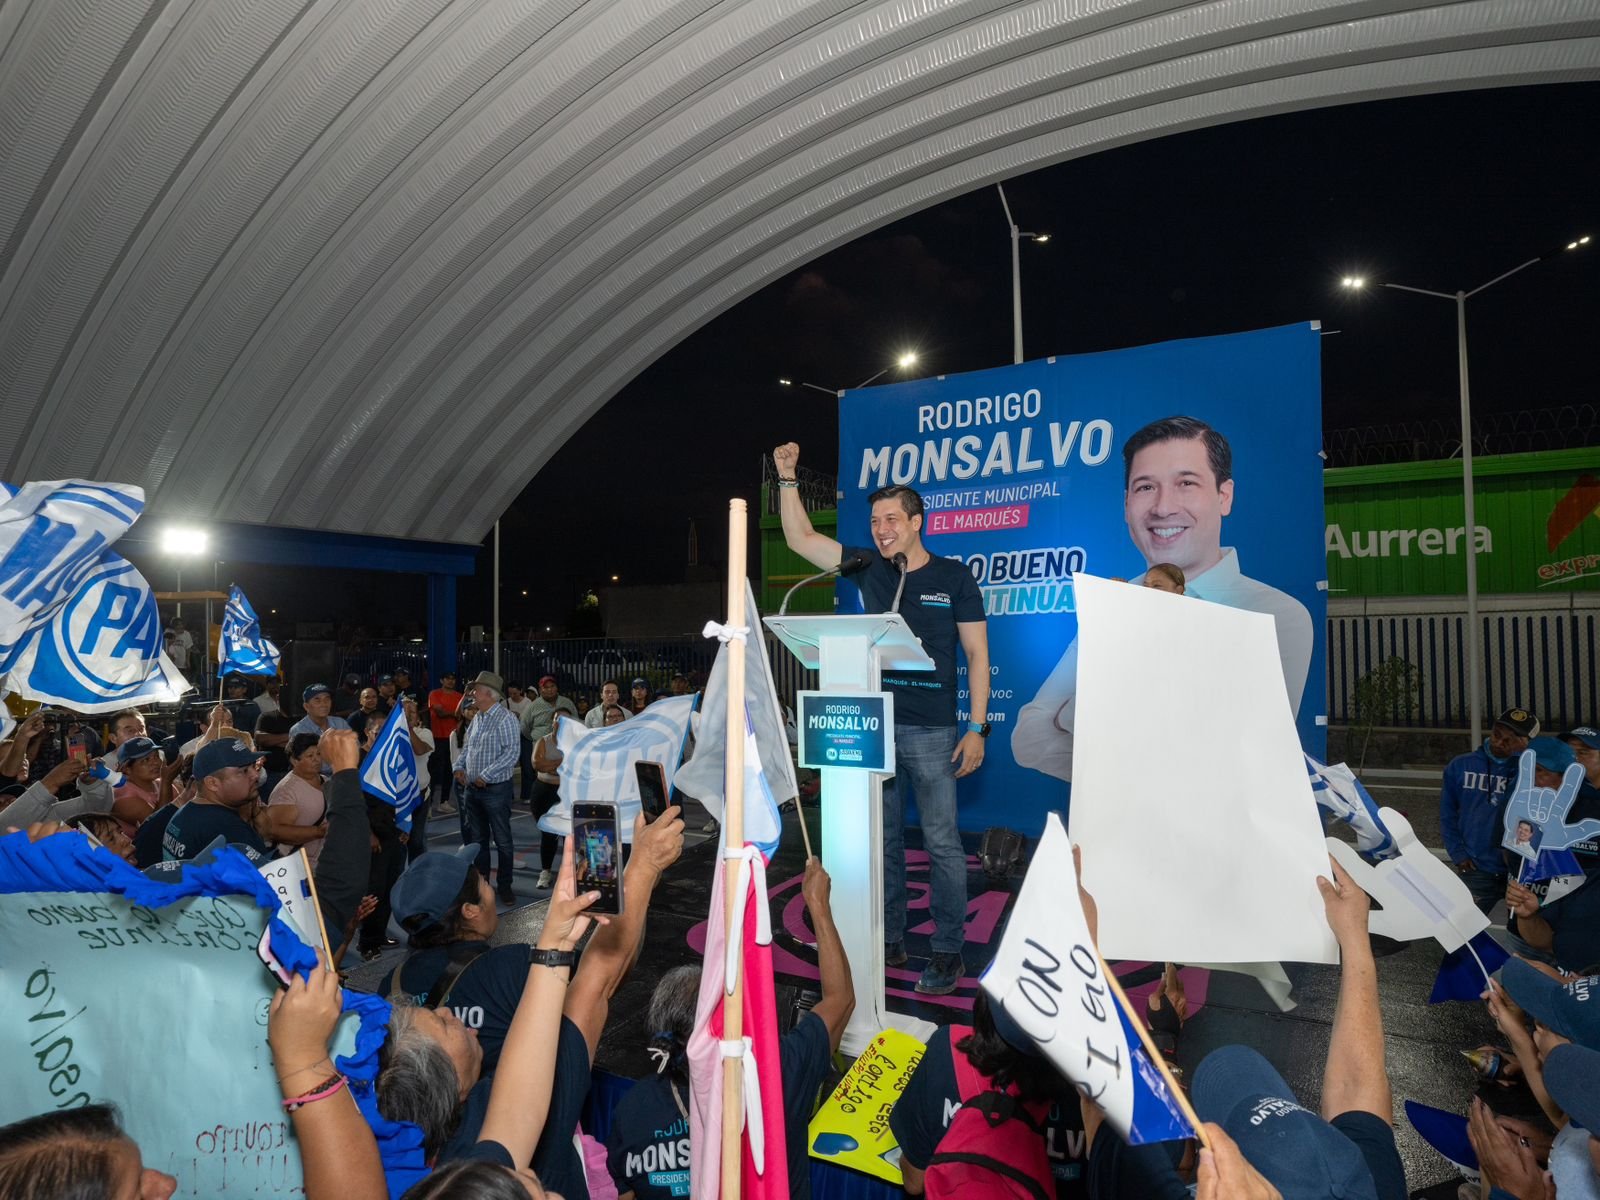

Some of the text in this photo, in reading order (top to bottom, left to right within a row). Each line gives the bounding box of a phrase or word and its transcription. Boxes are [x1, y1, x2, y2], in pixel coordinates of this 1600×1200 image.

[919, 388, 1041, 433] RODRIGO
[858, 419, 1113, 489] MONSALVO
[920, 481, 1061, 510] SIDENTE MUNICIPAL
[933, 507, 1021, 531] EL MARQUÉS
[1325, 523, 1493, 558] Aurrera
[989, 547, 1086, 583] BUENO
[808, 715, 879, 731] MONSALVO
[825, 705, 861, 715] RODRIGO
[1463, 771, 1508, 794] DUK
